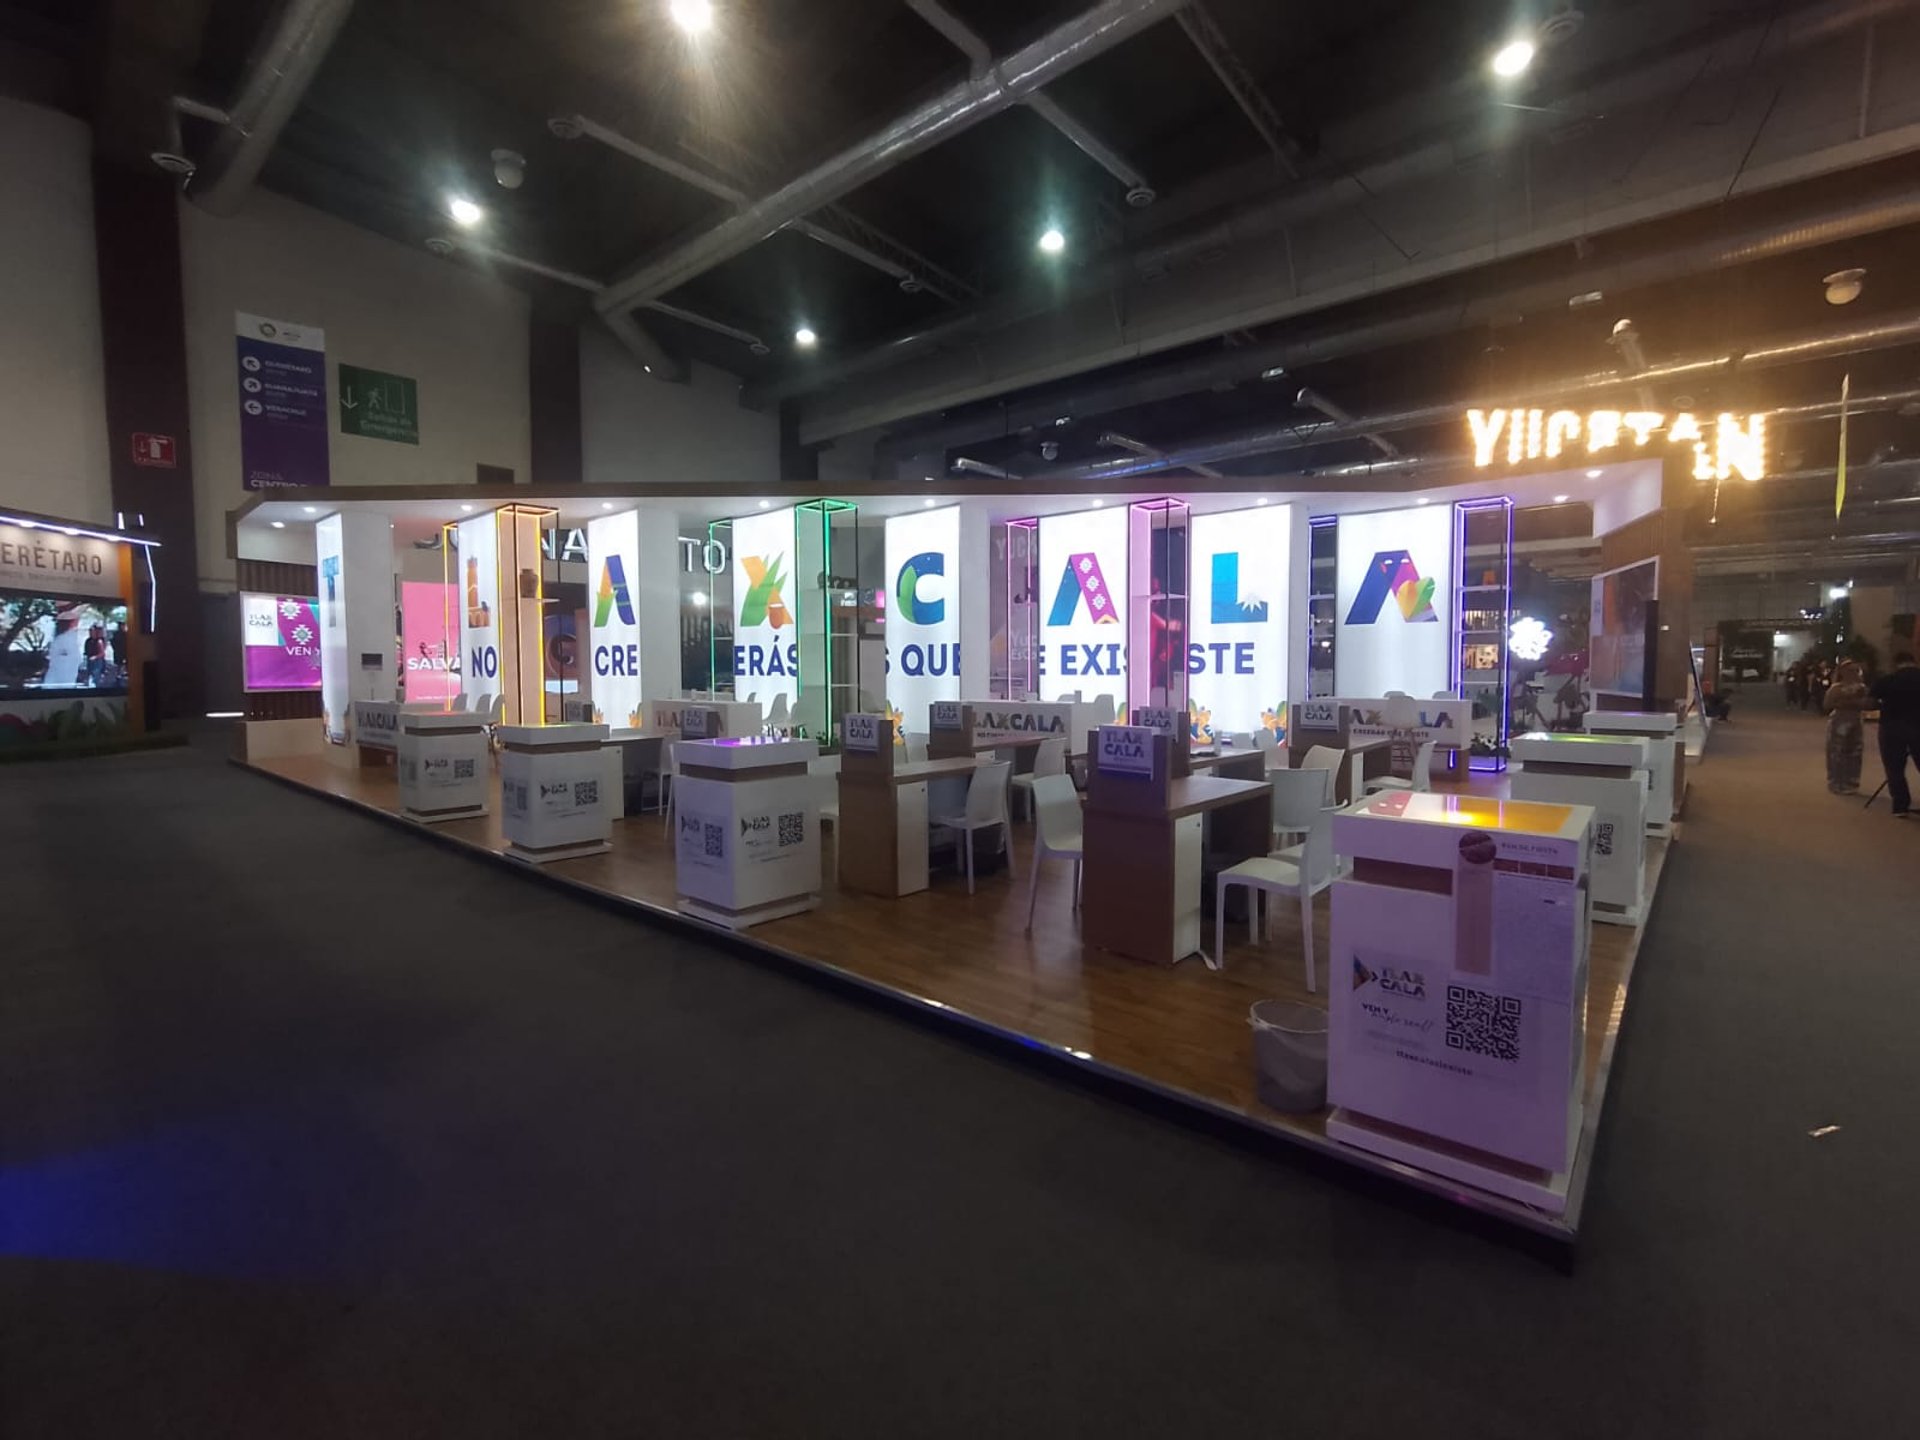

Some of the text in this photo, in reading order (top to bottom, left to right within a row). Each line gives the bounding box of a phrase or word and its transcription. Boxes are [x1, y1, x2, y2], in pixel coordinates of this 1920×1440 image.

[285, 646, 312, 656] VEN
[471, 645, 497, 678] NO
[1060, 643, 1129, 676] EXI
